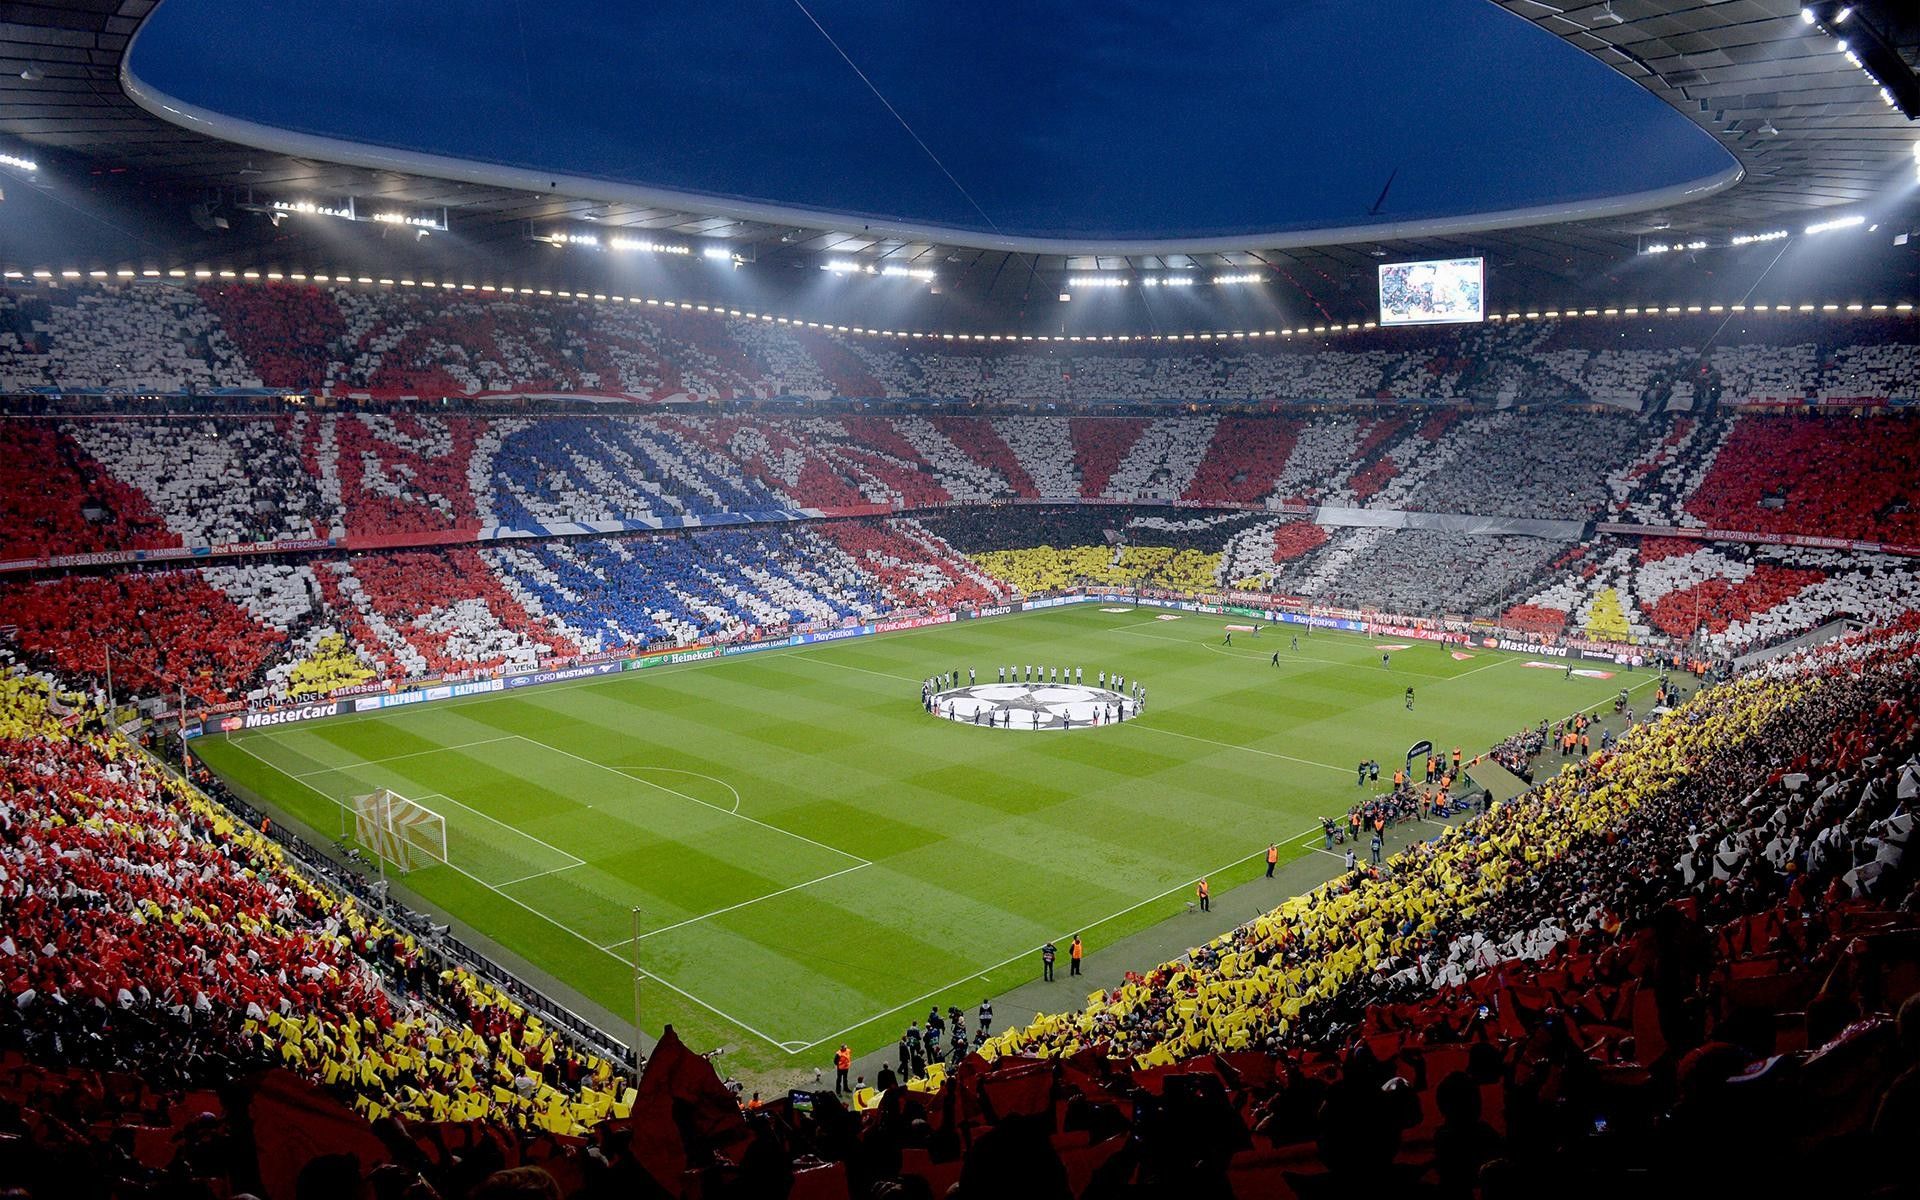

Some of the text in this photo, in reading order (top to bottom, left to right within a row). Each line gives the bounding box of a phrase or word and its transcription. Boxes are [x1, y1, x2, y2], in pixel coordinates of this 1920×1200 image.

[1713, 530, 1725, 538] DIE
[1725, 531, 1747, 540] ROTEN
[211, 543, 276, 554] Red Wood Cats
[277, 540, 328, 549] POTTSCHACH
[92, 553, 113, 564] BOOS
[152, 547, 191, 557] MAINBURG
[981, 606, 1011, 617] Maestro
[883, 615, 949, 632] UniCredit UniCredit
[1293, 614, 1337, 628] PlayStation
[813, 629, 855, 642] PlayStation
[1378, 625, 1415, 637] UniCredit
[741, 642, 770, 652] CHAMPIONS
[771, 638, 790, 648] LEAGUE
[1499, 638, 1567, 657] MasterCard
[671, 650, 714, 664] Heineken
[534, 667, 595, 682] FORD MUSTANG
[455, 680, 492, 696] GAZPROM
[384, 691, 423, 706] GAZPROM
[245, 703, 337, 728] MasterCard
